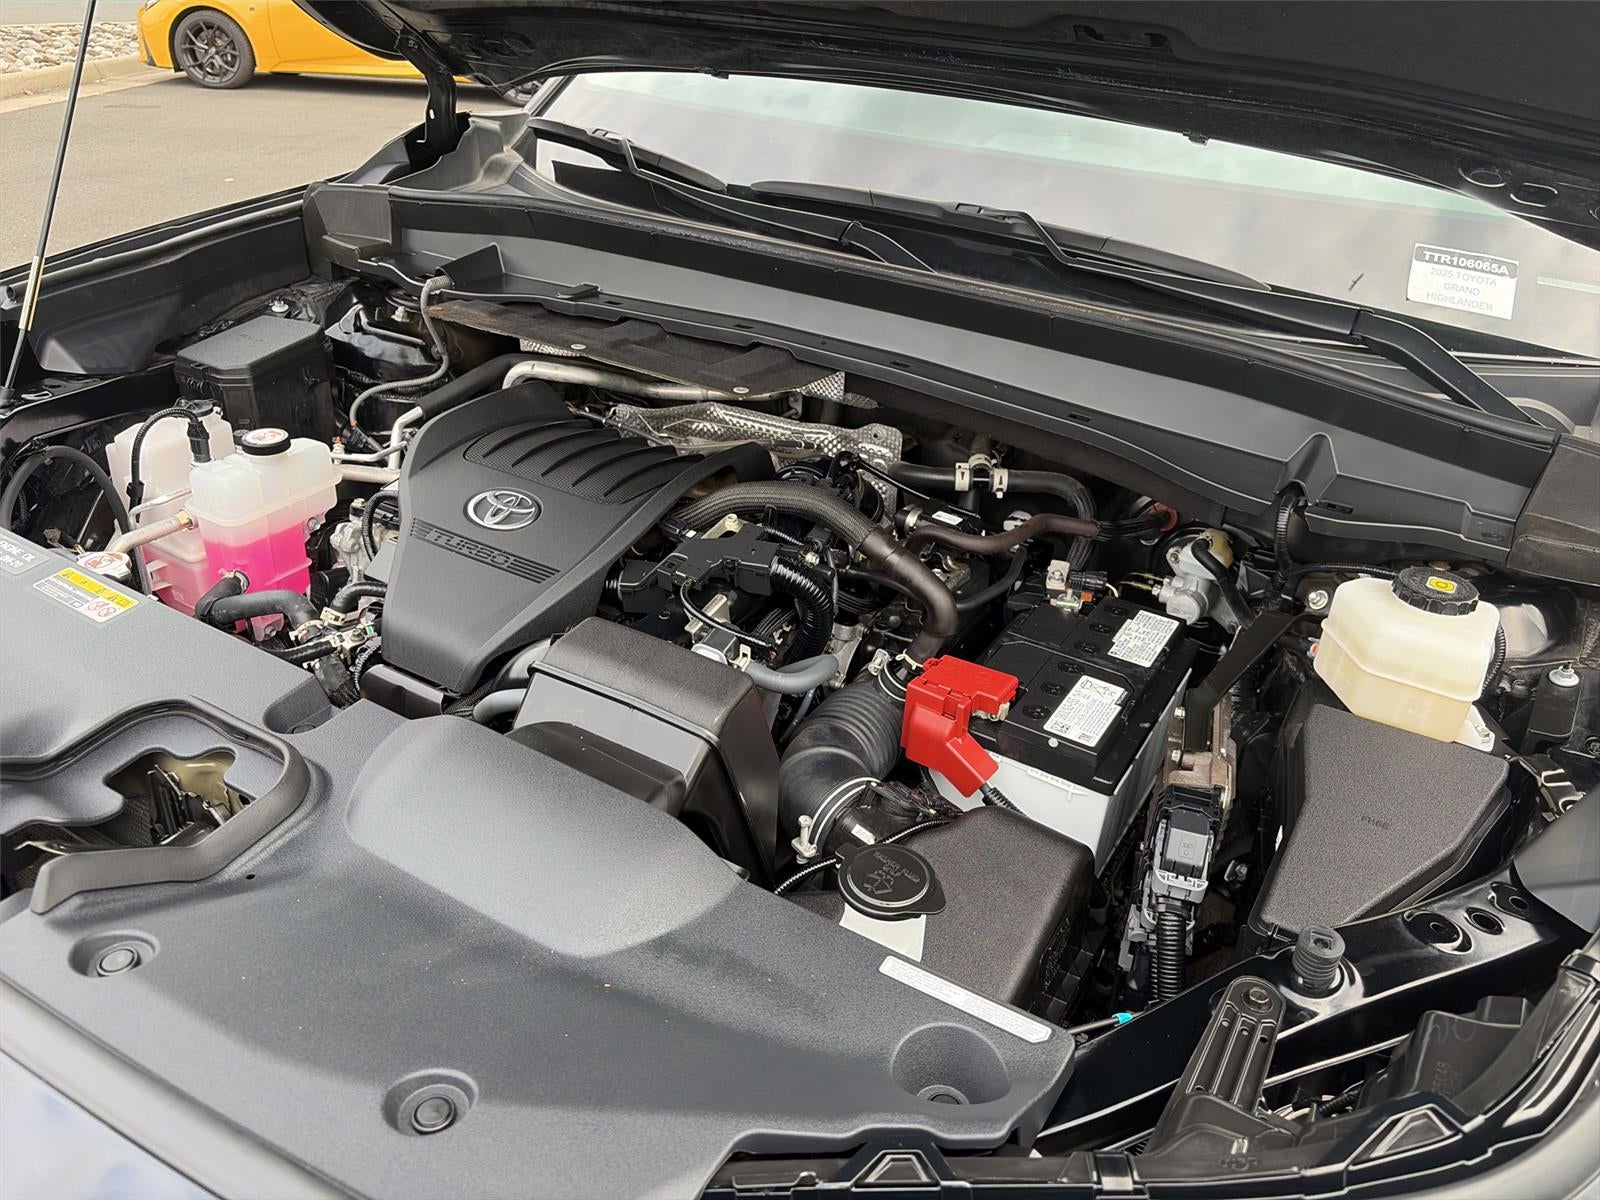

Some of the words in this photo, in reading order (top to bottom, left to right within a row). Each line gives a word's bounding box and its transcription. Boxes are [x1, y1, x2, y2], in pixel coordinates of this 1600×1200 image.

[1423, 250, 1510, 276] TTR106065A
[1430, 267, 1454, 279] 2025
[1456, 271, 1498, 287] TOYOTA
[1443, 282, 1481, 297] GRAND
[1426, 291, 1494, 312] HIGHLANDER
[432, 529, 511, 567] TURBO
